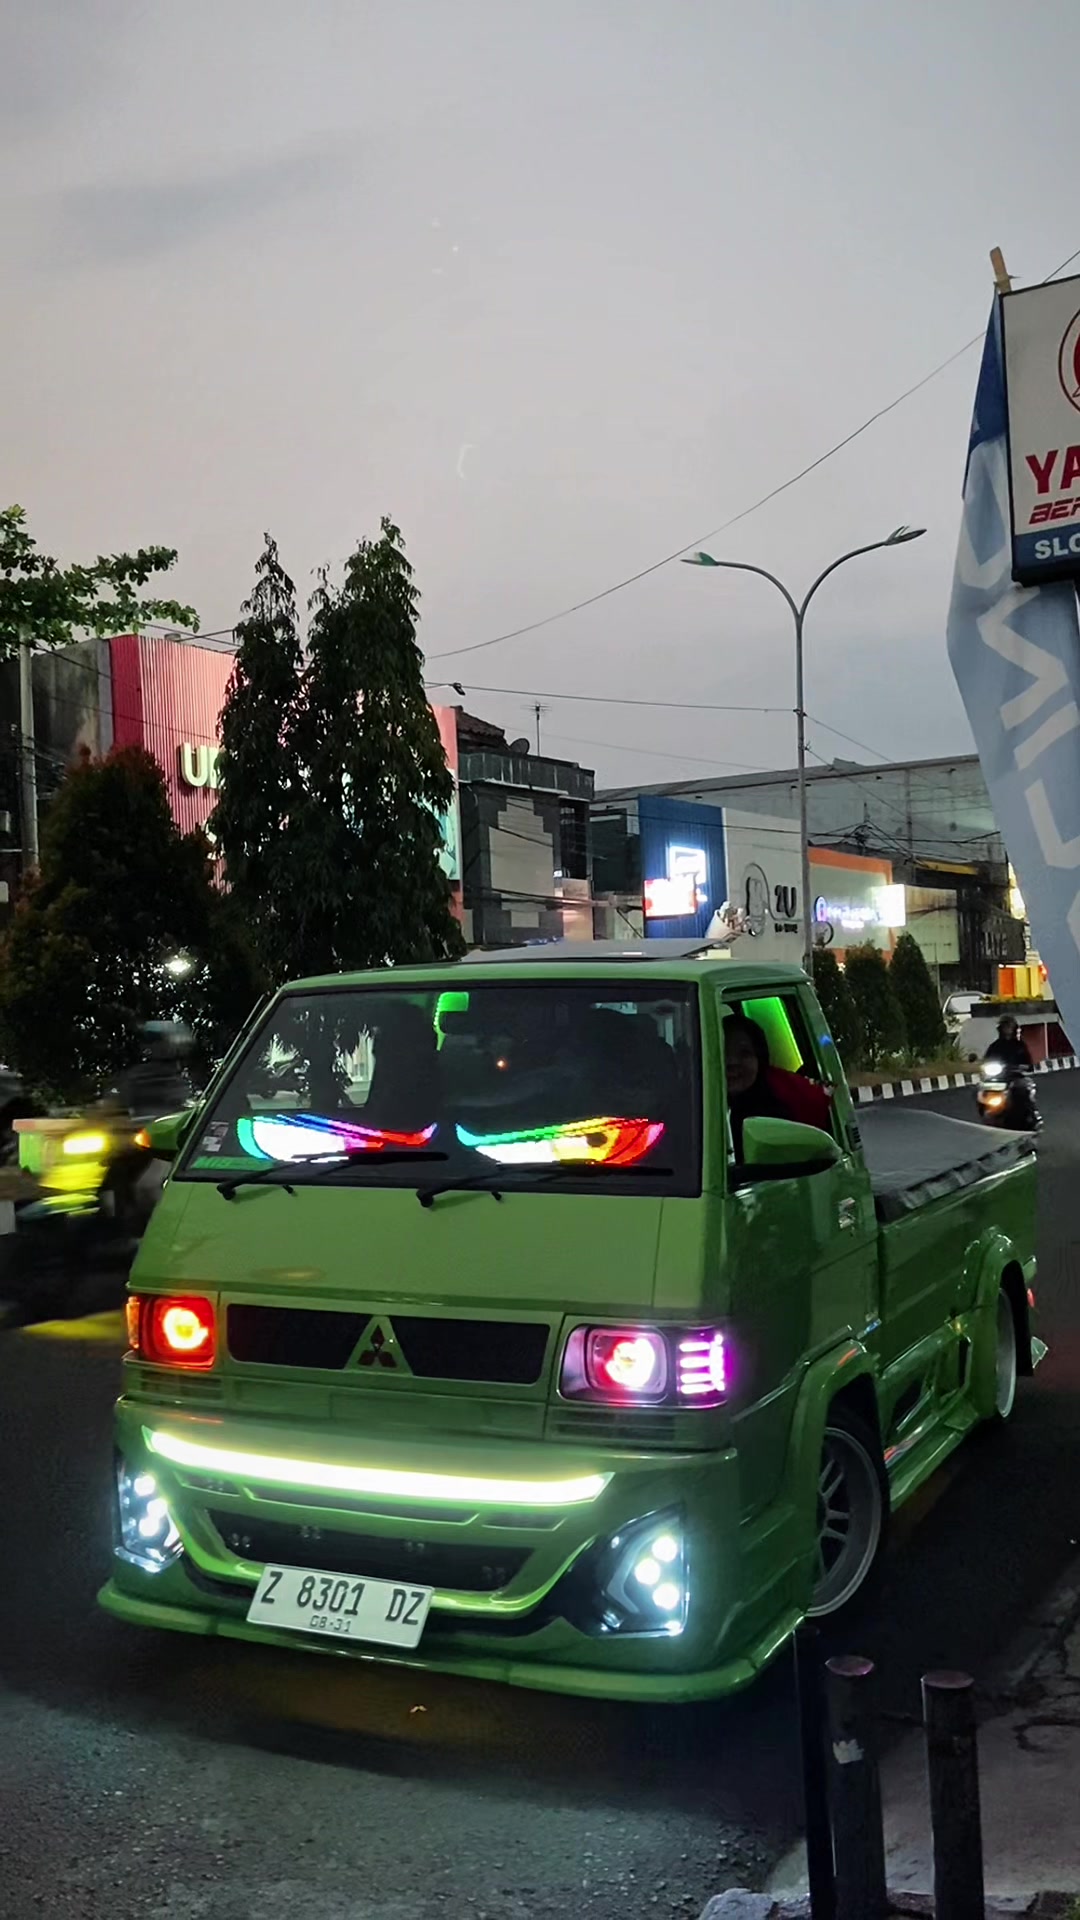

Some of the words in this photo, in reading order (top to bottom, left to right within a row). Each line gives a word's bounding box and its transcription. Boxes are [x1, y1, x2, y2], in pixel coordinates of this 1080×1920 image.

[260, 1571, 283, 1604] Z
[296, 1575, 366, 1616] 8301
[384, 1588, 426, 1626] DZ
